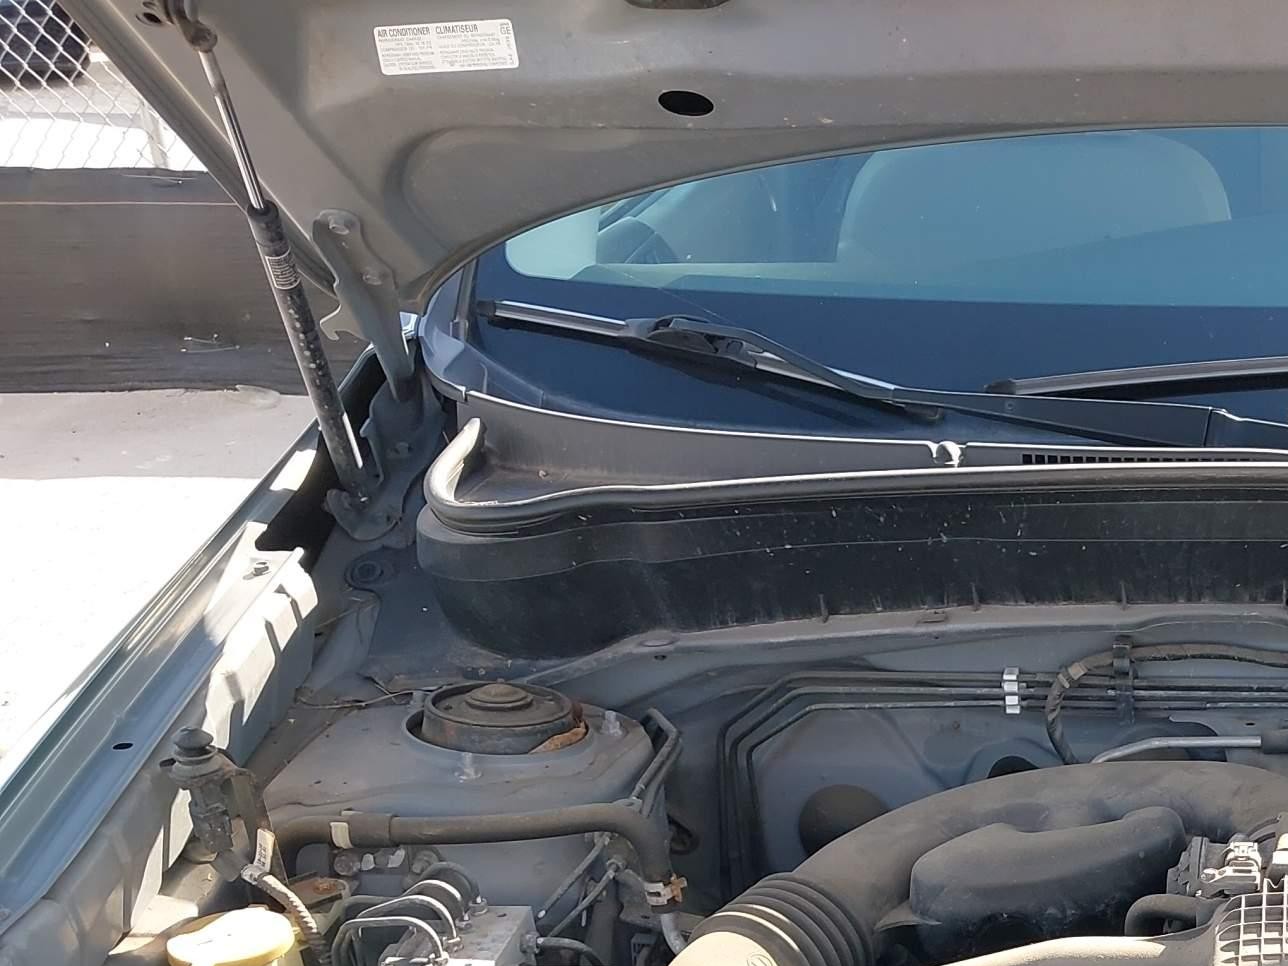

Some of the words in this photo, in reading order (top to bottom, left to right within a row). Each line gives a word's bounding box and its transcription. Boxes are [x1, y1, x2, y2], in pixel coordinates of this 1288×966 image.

[378, 29, 388, 38] AIR
[389, 26, 431, 37] CONDITIONER
[435, 24, 479, 35] CLIMATISEUR
